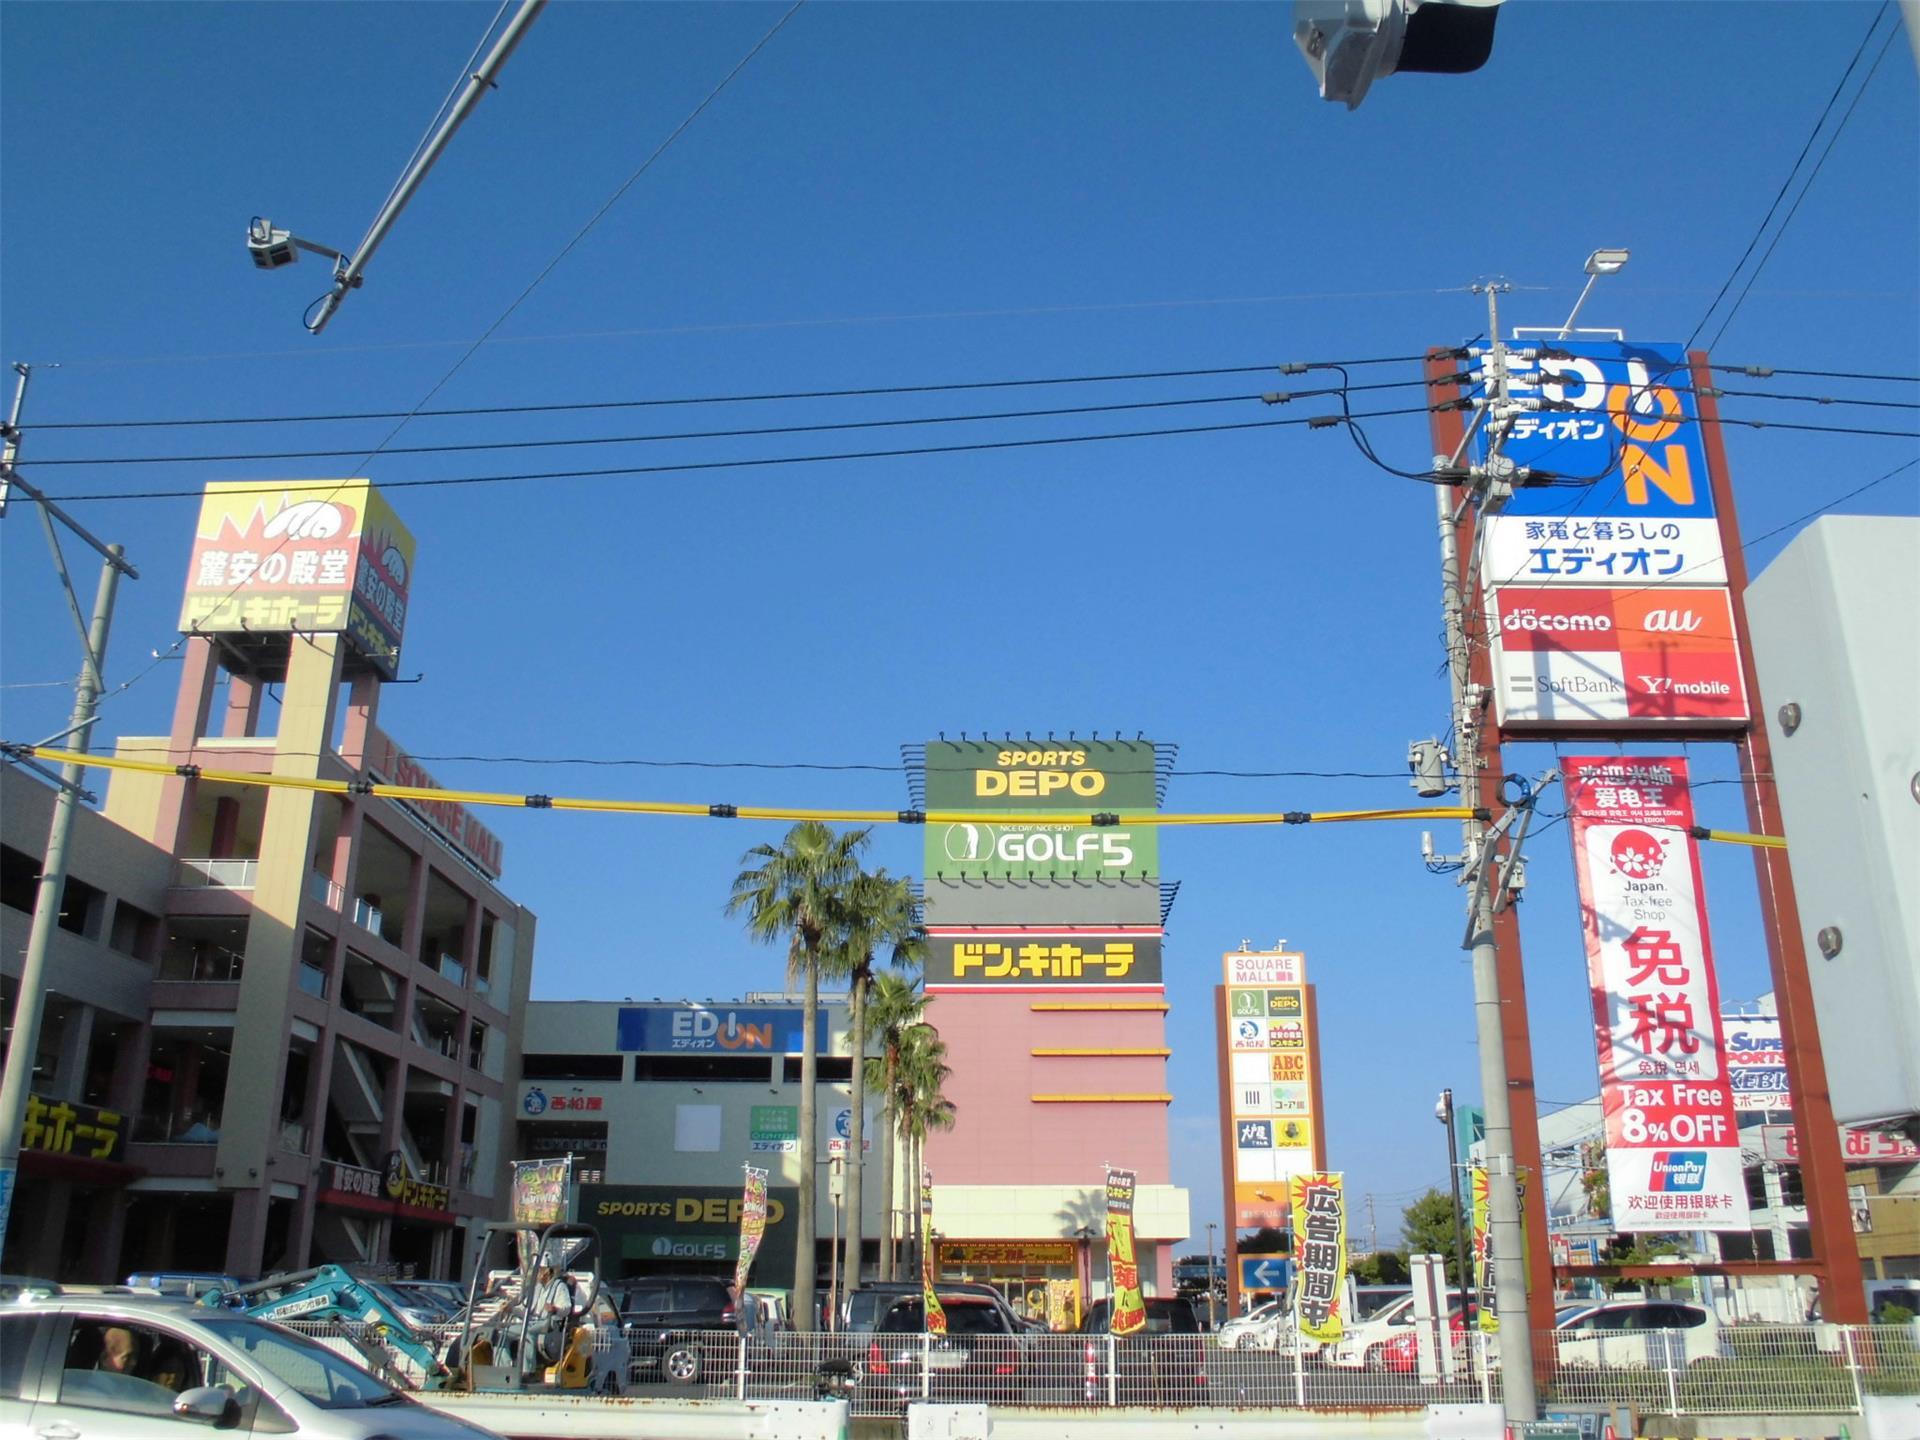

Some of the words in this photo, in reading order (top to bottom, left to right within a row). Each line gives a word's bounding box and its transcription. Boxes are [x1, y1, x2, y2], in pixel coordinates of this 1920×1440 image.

[1525, 521, 1681, 541] 家電と暮らしの
[197, 550, 349, 586] 驚安の殿堂
[1529, 547, 1685, 576] エディオン
[1504, 609, 1611, 631] docomo
[1643, 609, 1702, 632] au
[1538, 676, 1620, 694] SoftBank
[1674, 680, 1730, 695] mobile
[997, 751, 1086, 766] SPORTS
[975, 769, 1105, 797] DEPO
[1595, 787, 1666, 808] 爱电王
[997, 832, 1133, 867] GOLF5
[1634, 908, 1666, 922] Shop
[1236, 959, 1293, 970] SQUARE
[1236, 971, 1277, 982] MALL
[1621, 926, 1700, 1055] 免税
[1270, 1000, 1299, 1008] DEPO
[672, 1010, 772, 1049] EDION
[672, 1038, 716, 1048] エディオン
[1730, 1031, 1783, 1051] SUPE
[1273, 1056, 1304, 1069] ABC
[1727, 1052, 1785, 1065] PORTS
[1273, 1071, 1304, 1081] MART
[551, 1096, 603, 1111] 西松屋
[1616, 1084, 1665, 1106] Tax
[1672, 1084, 1722, 1107] Free
[752, 1141, 795, 1150] エディオン
[1653, 1161, 1703, 1175] UnionPay
[598, 1201, 671, 1216] SPORTS
[1628, 1195, 1733, 1210] 欢迎使用银联卡
[672, 1242, 726, 1259] GOLF5
[1301, 1185, 1340, 1330] 広告期間中
